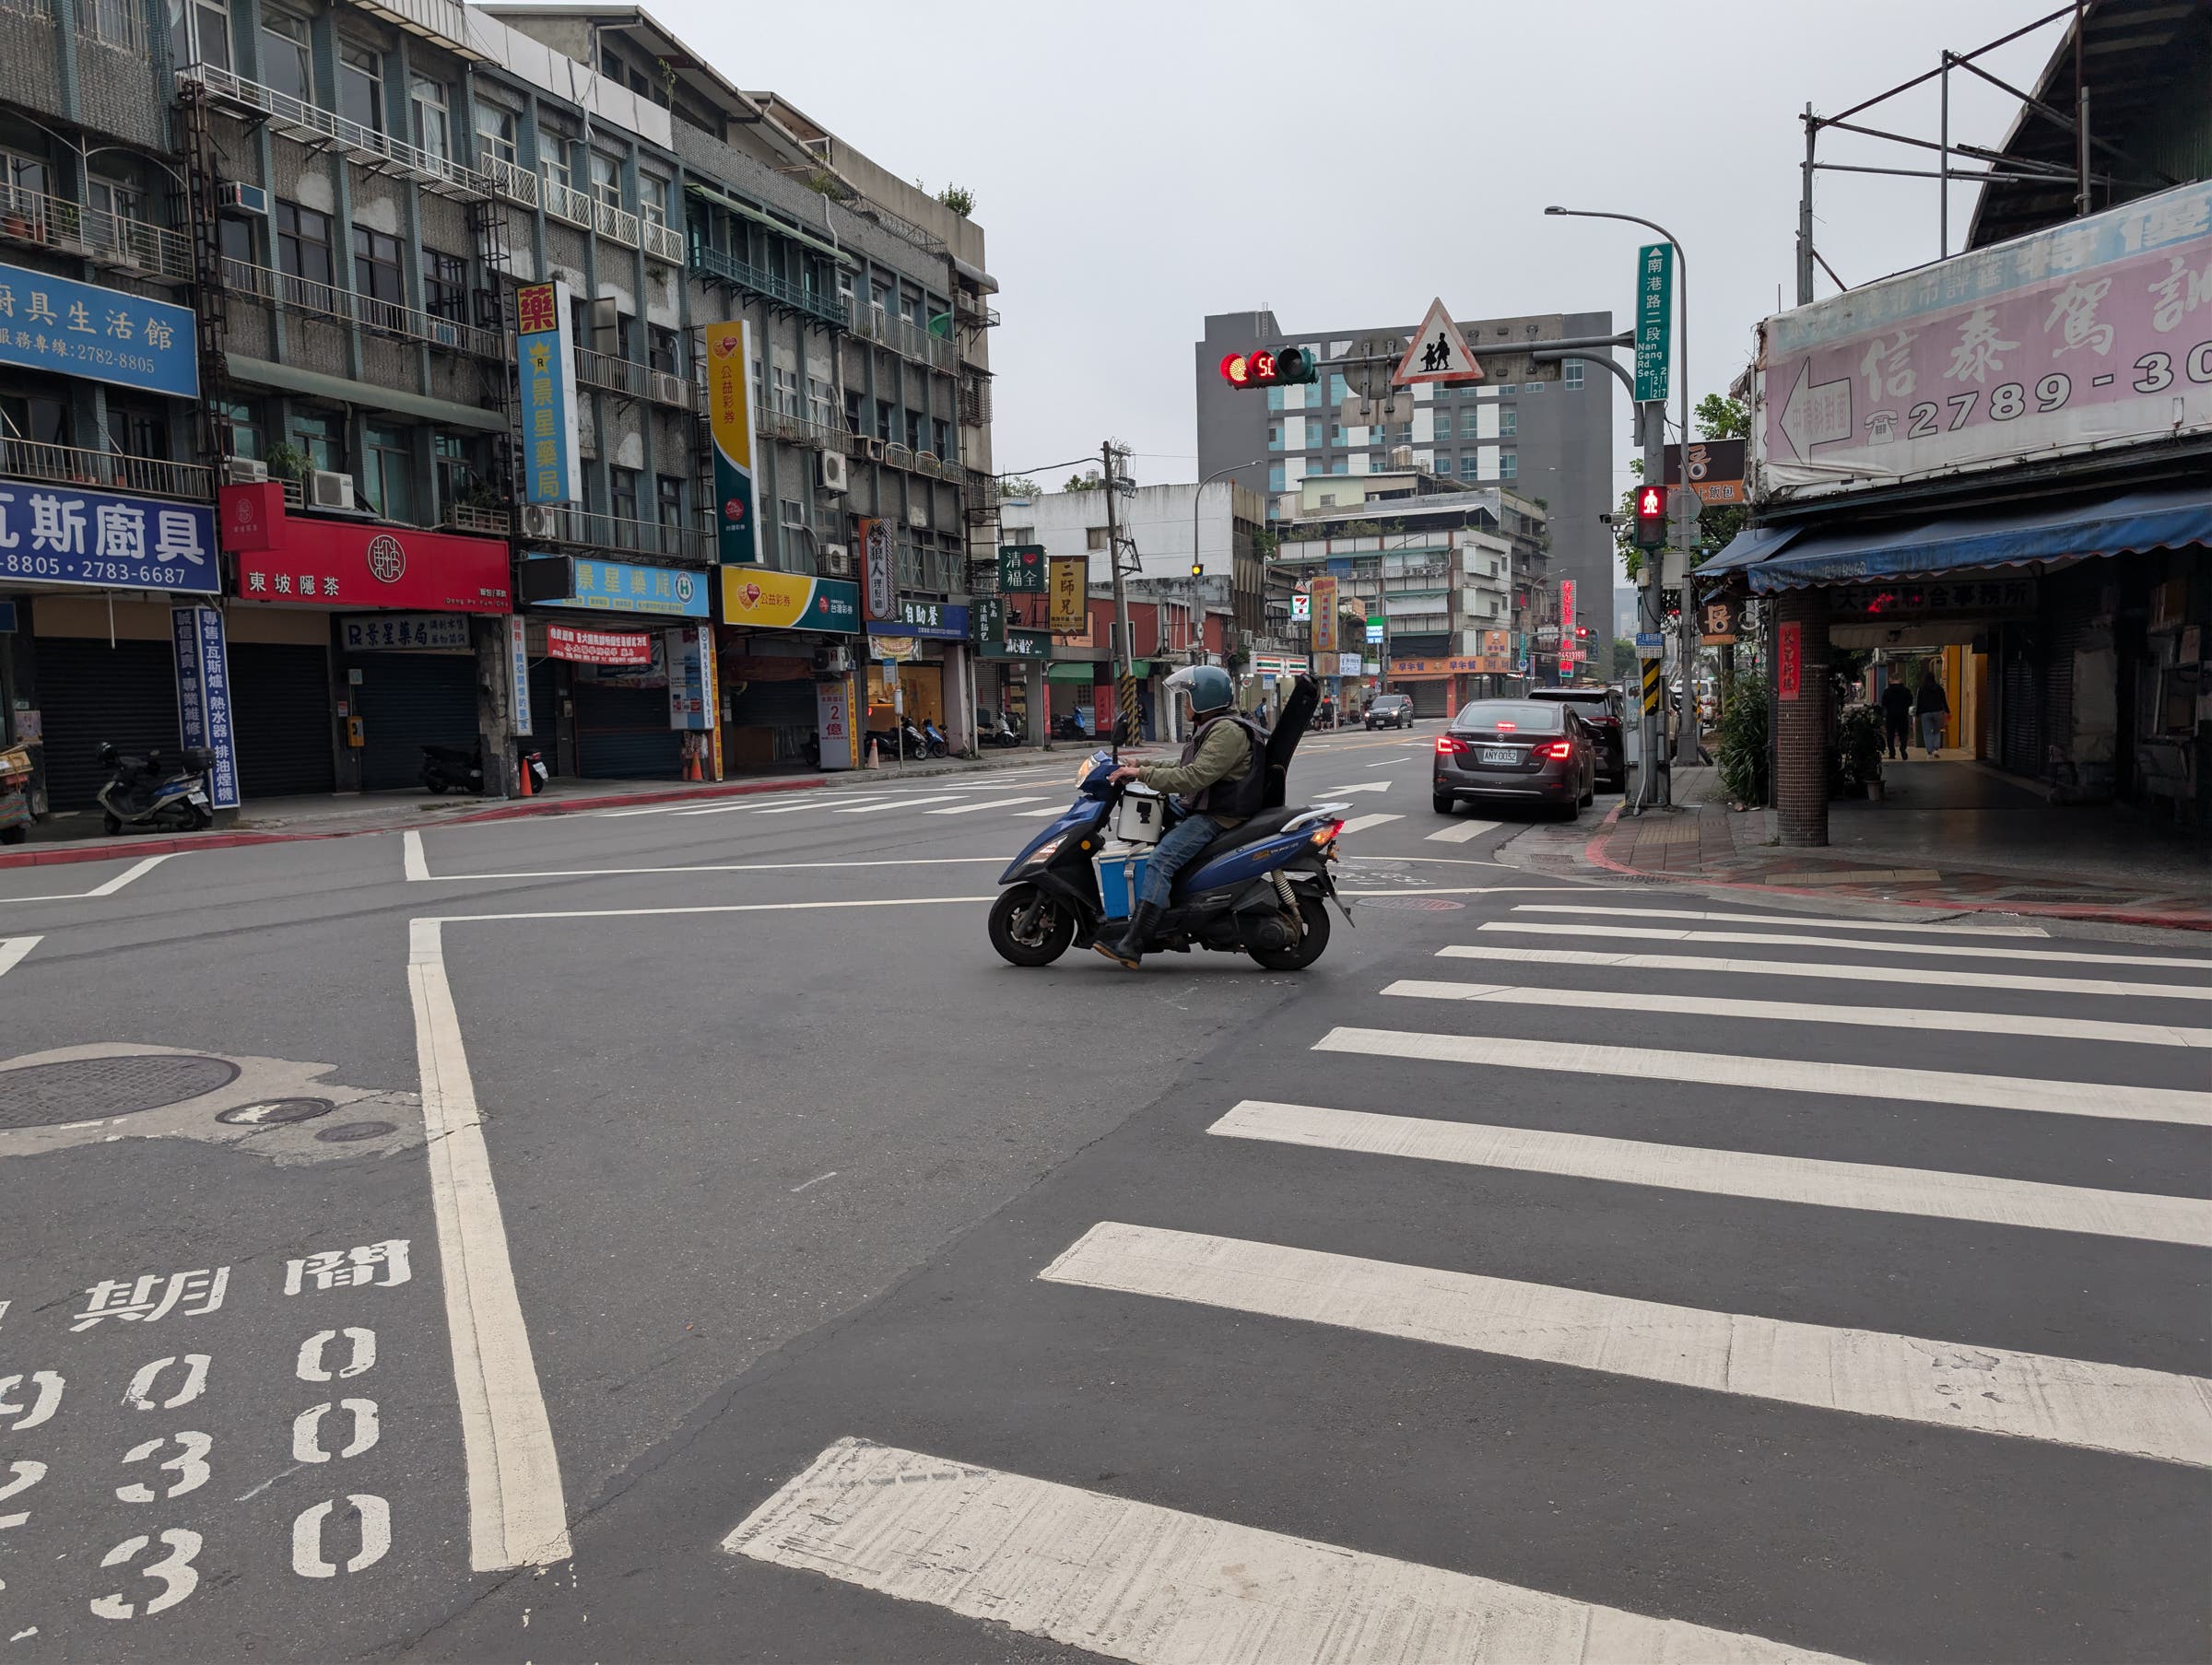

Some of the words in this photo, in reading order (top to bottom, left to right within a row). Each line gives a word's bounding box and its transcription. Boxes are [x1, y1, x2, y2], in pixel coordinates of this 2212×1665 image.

[1645, 258, 1663, 342] 南港路二段
[519, 287, 555, 332] 藥
[1638, 343, 1657, 351] Nan
[1638, 351, 1663, 361] Gang
[1638, 360, 1653, 369] Rd.
[1638, 369, 1658, 378] Sec.
[1660, 367, 1667, 376] 2
[1653, 375, 1667, 385] 211
[721, 365, 735, 425] 公益彩券
[1653, 388, 1666, 398] 217
[531, 377, 559, 499] 景星藥局
[81, 560, 186, 585] 2783-6687
[576, 563, 671, 598] 景星藥局
[1007, 569, 1038, 587] 福全
[1060, 564, 1076, 616] 二師兄
[760, 592, 791, 607] 公益彩券
[365, 619, 428, 647] 景星藥局
[830, 706, 840, 720] 2
[826, 723, 842, 736] 億
